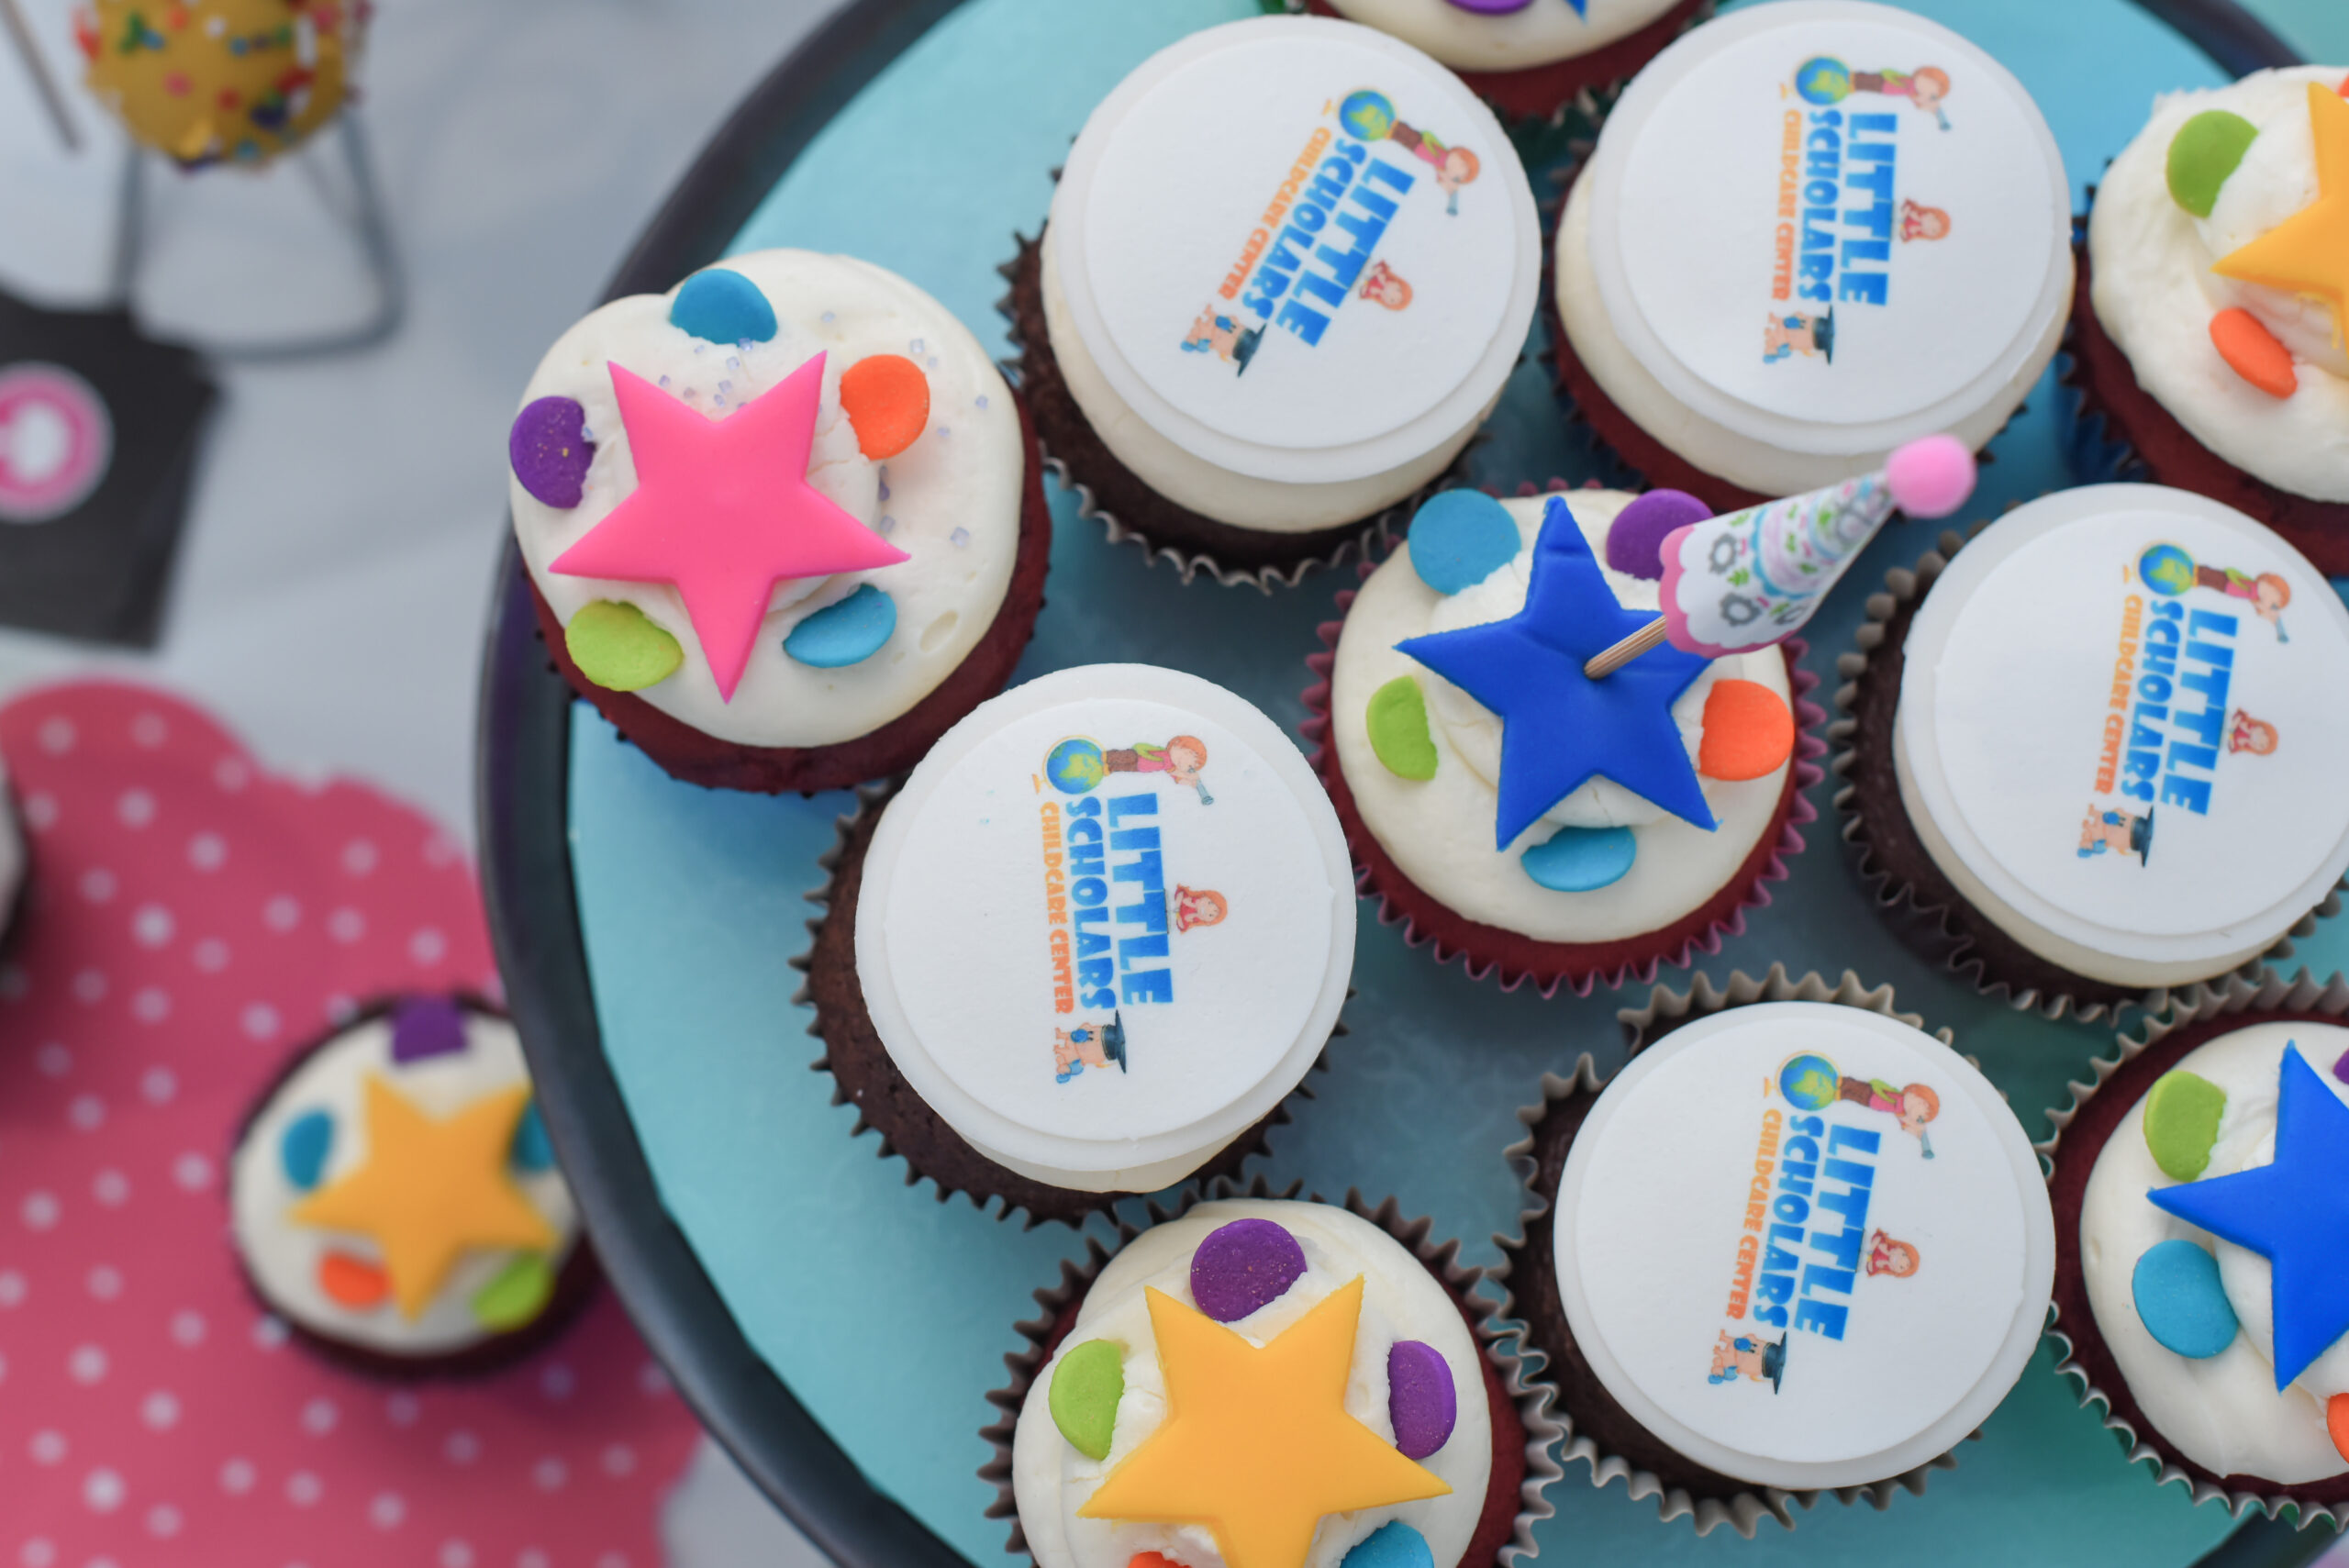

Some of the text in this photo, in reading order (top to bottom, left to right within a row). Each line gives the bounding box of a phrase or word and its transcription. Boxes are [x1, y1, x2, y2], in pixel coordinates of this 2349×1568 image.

[1218, 127, 1331, 301] CHILDCARE CENTER
[1241, 138, 1367, 320] SCHOLARS
[1275, 157, 1416, 348] LITTLE
[1771, 109, 1801, 301] CHILDCARE CENTER
[1798, 109, 1842, 303] SCHOLARS
[1838, 113, 1898, 306] LITTLE
[2093, 595, 2143, 795] CHILDCARE CENTER
[2121, 600, 2185, 803] SCHOLARS
[2160, 608, 2238, 816] LITTLE
[1040, 801, 1074, 1014] CHILDCARE CENTER
[1065, 795, 1118, 1010] SCHOLARS
[1108, 792, 1174, 1006] LITTLE
[1726, 1107, 1783, 1320] CHILDCARE CENTER
[1753, 1115, 1824, 1329] SCHOLARS
[1794, 1124, 1881, 1341] LITTLE
